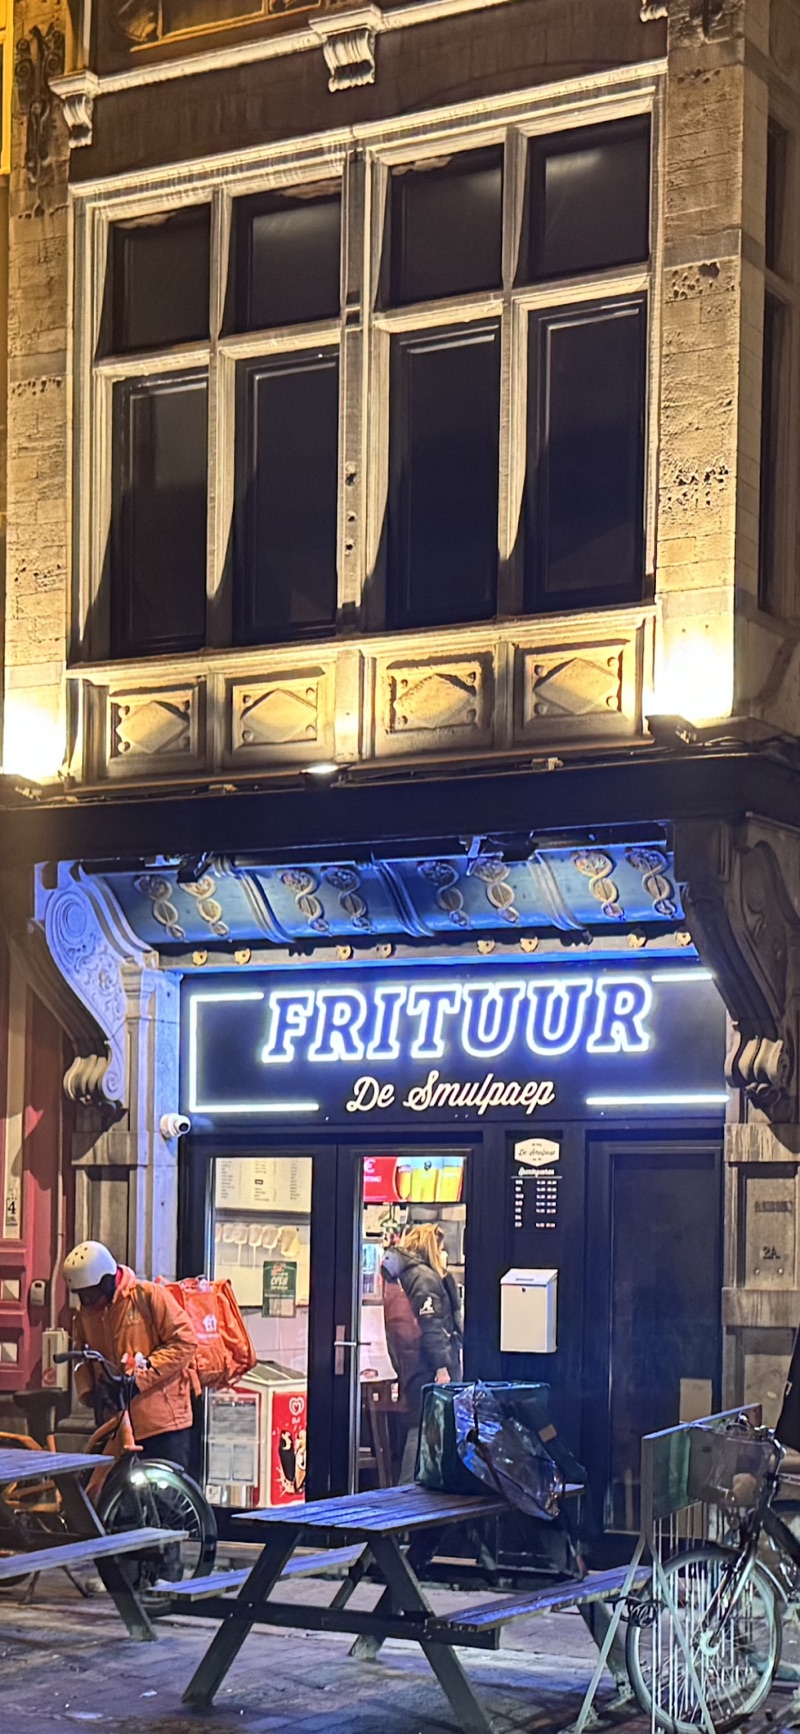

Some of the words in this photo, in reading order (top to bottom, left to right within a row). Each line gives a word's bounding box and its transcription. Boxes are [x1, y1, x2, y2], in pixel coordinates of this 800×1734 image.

[261, 976, 653, 1064] FRITUUR
[346, 1076, 395, 1112] De
[403, 1070, 555, 1115] Smulpaep
